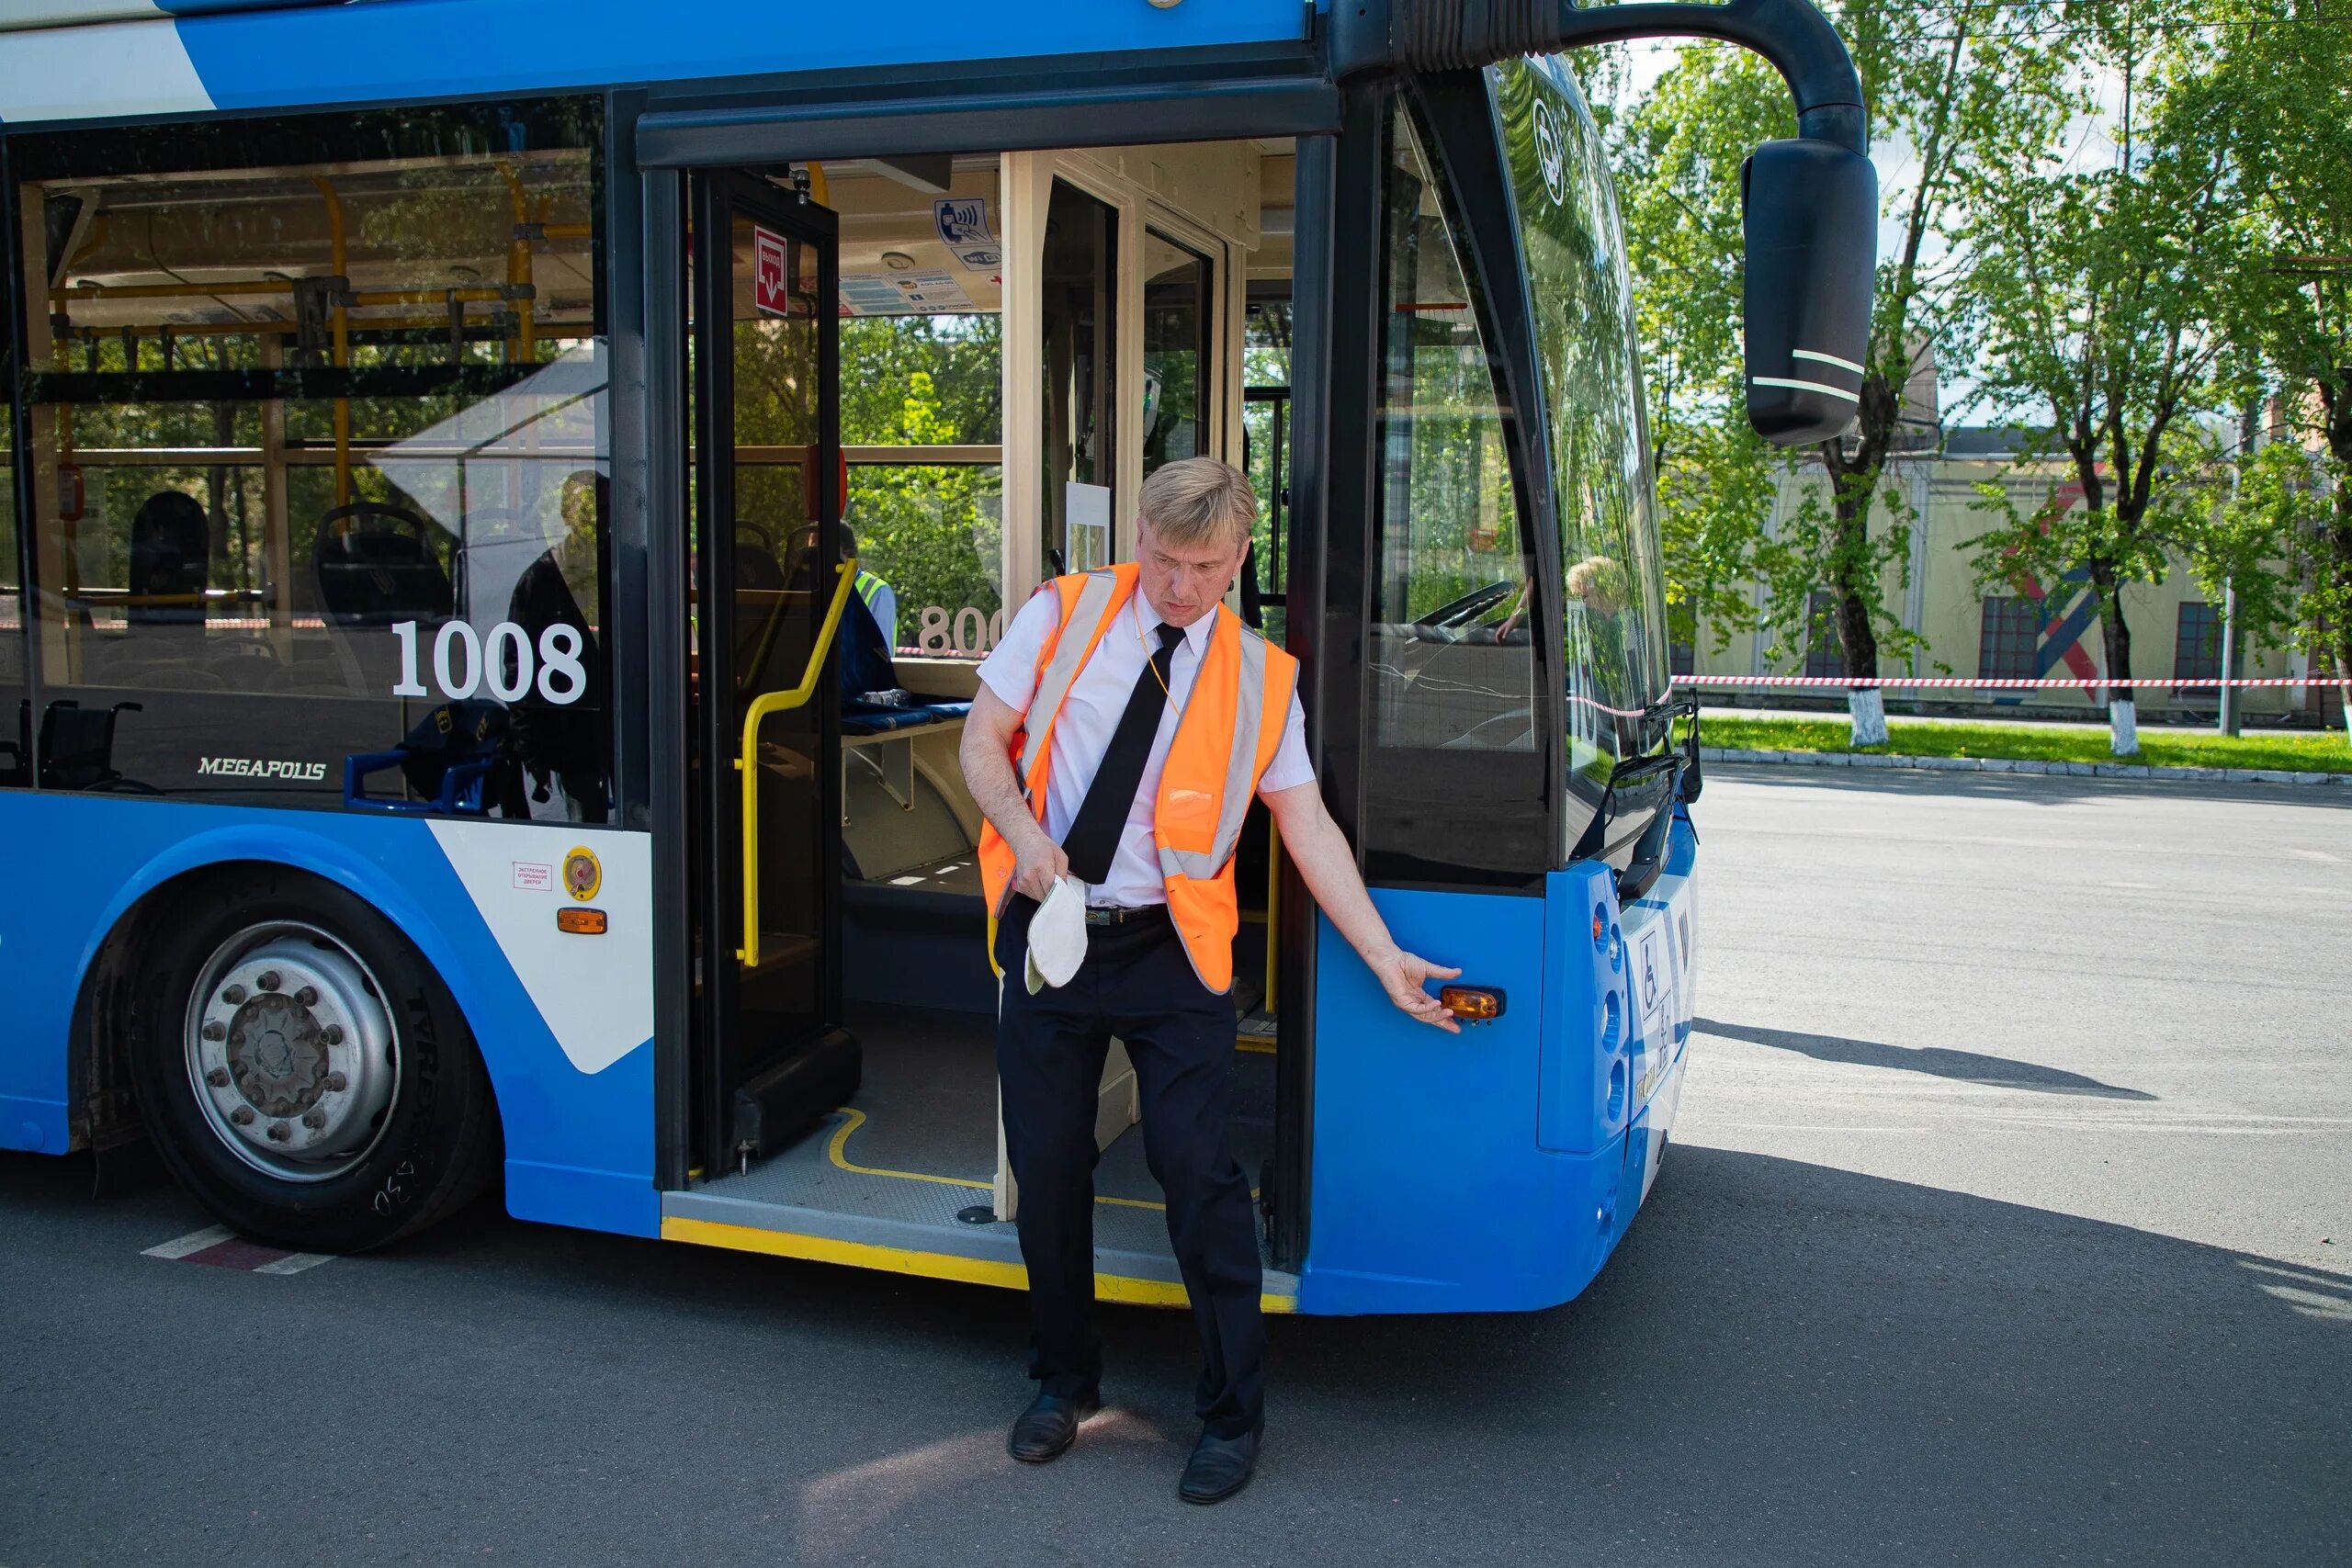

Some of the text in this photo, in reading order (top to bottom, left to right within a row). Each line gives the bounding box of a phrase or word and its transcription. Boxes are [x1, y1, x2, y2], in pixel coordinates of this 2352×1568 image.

[762, 251, 780, 268] ВЫХОД
[391, 620, 587, 705] 1008
[198, 757, 326, 781] MEGAPOLIS
